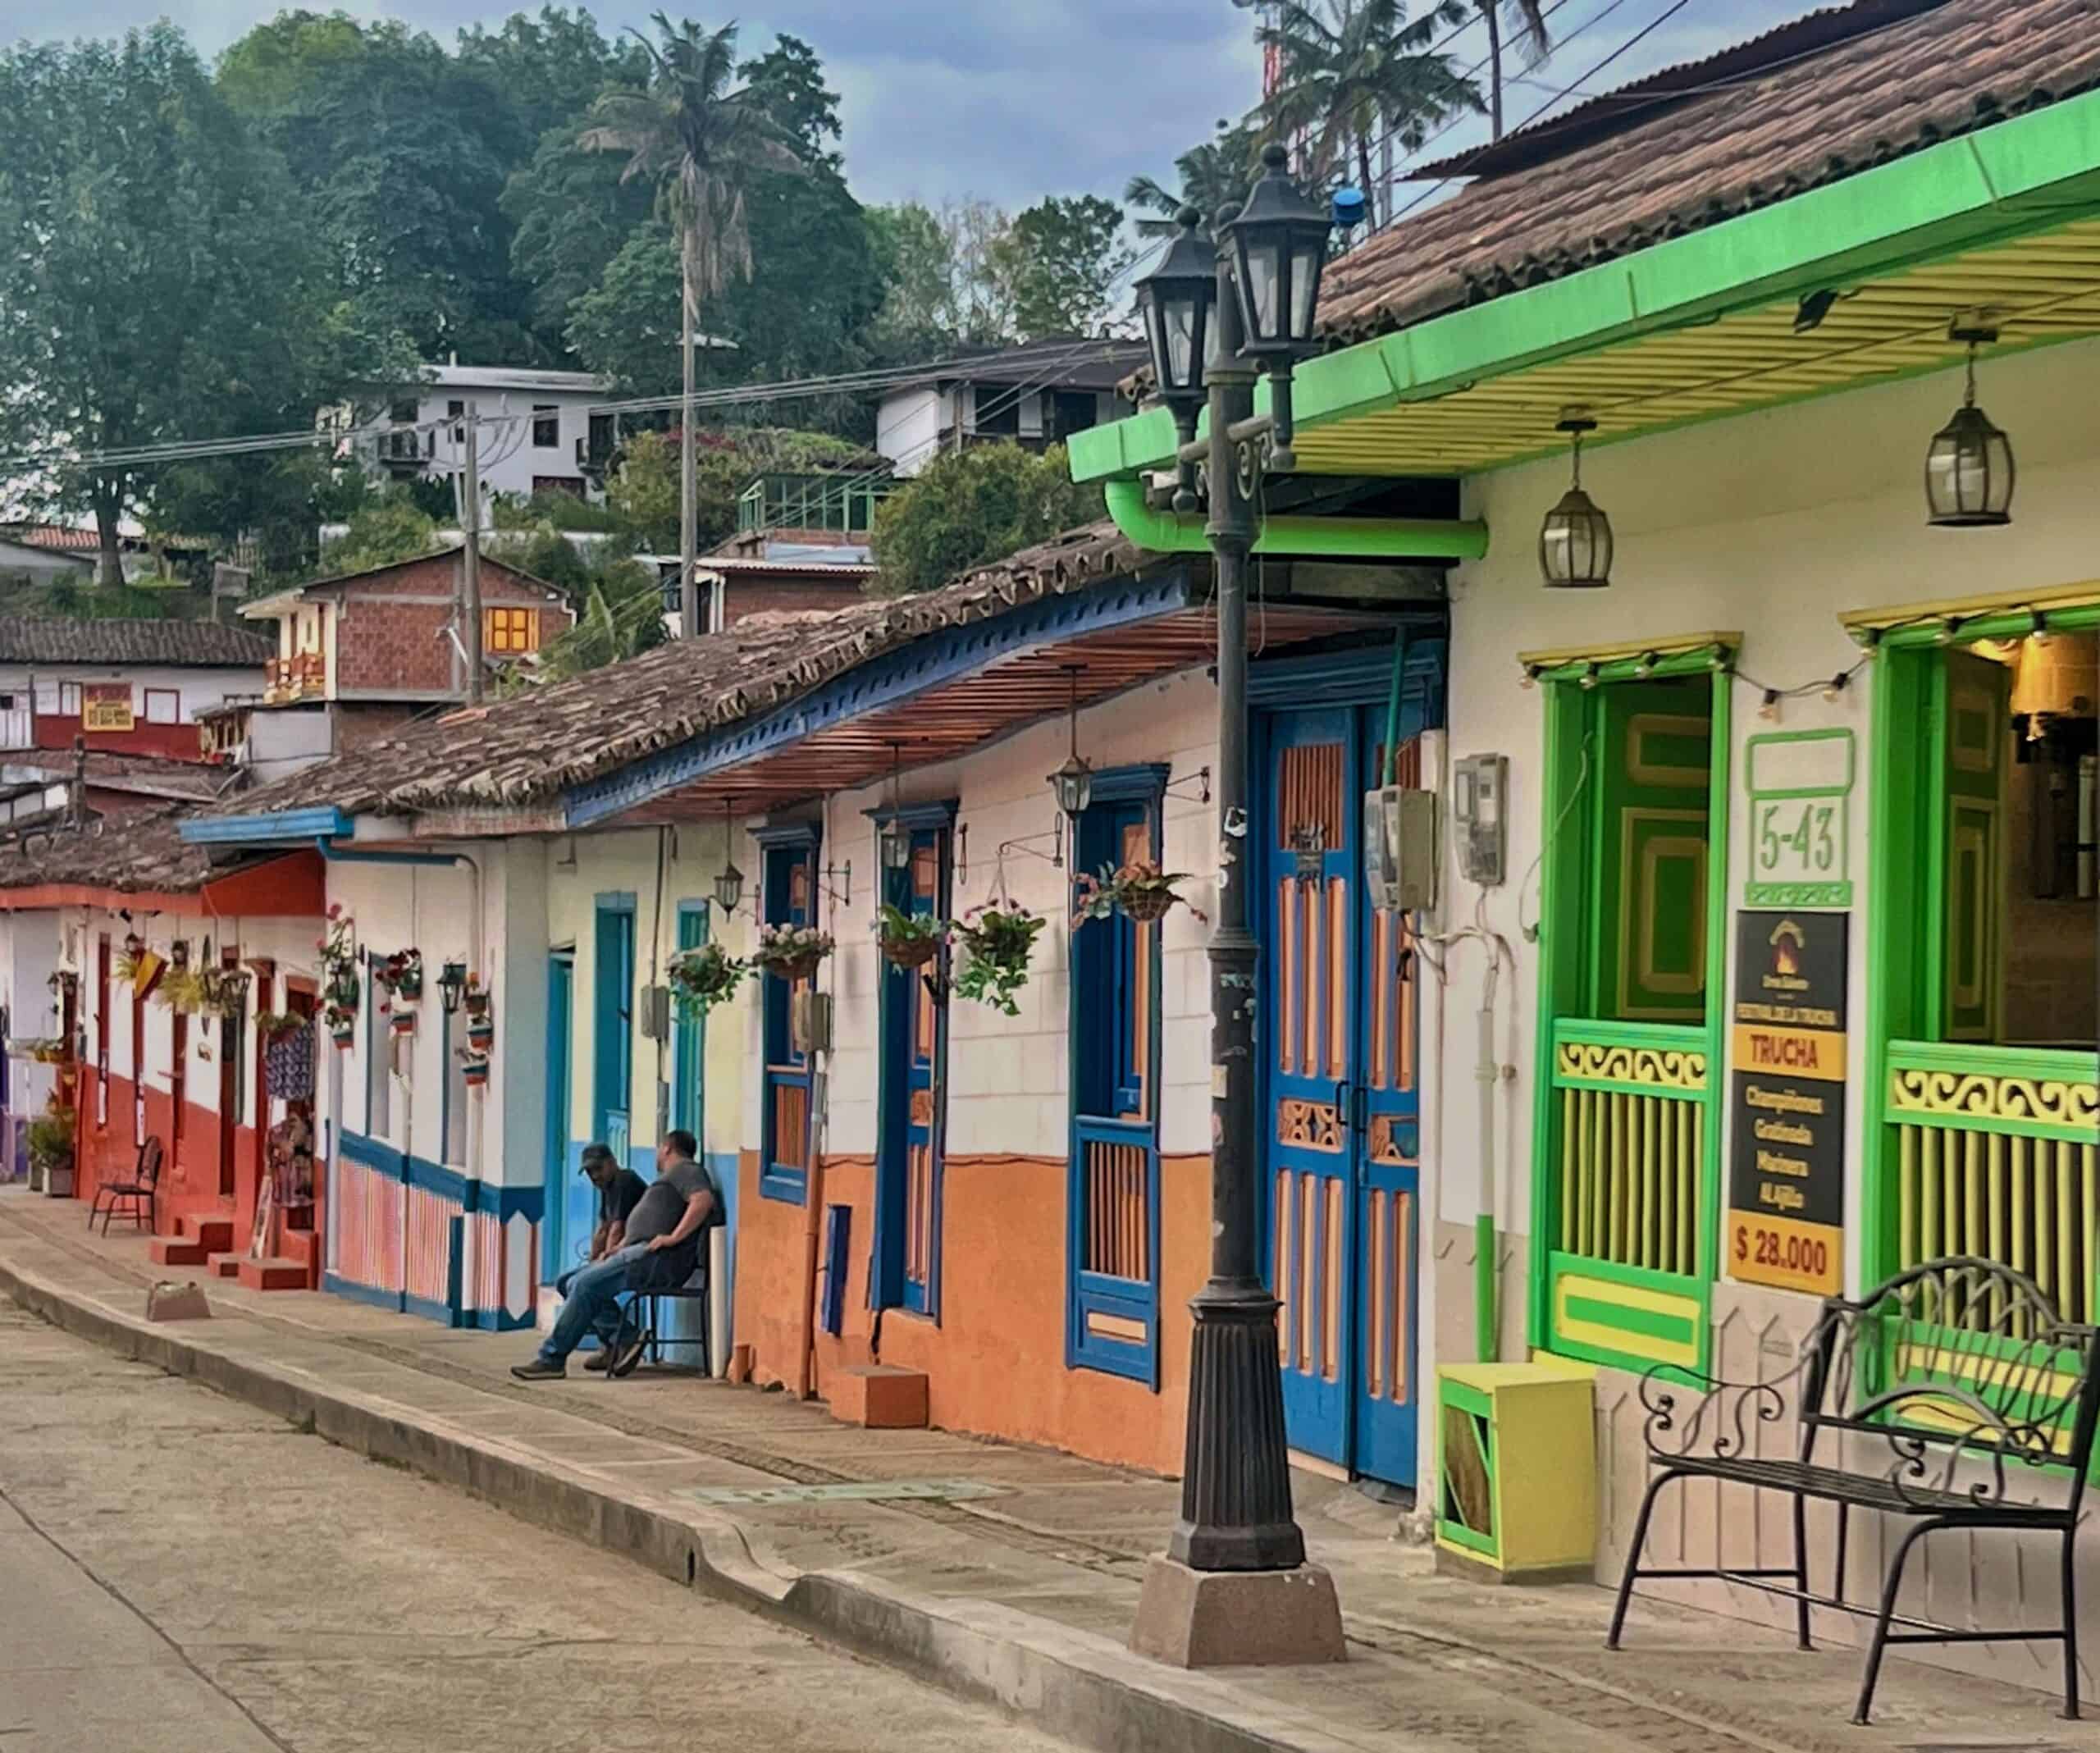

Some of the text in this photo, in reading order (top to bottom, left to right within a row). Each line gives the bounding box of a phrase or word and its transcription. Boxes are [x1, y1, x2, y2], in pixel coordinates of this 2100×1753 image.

[1760, 804, 1834, 870] 5-43
[1750, 1033, 1819, 1069] TRUCHA
[1736, 1226, 1826, 1276] $ 28.000
